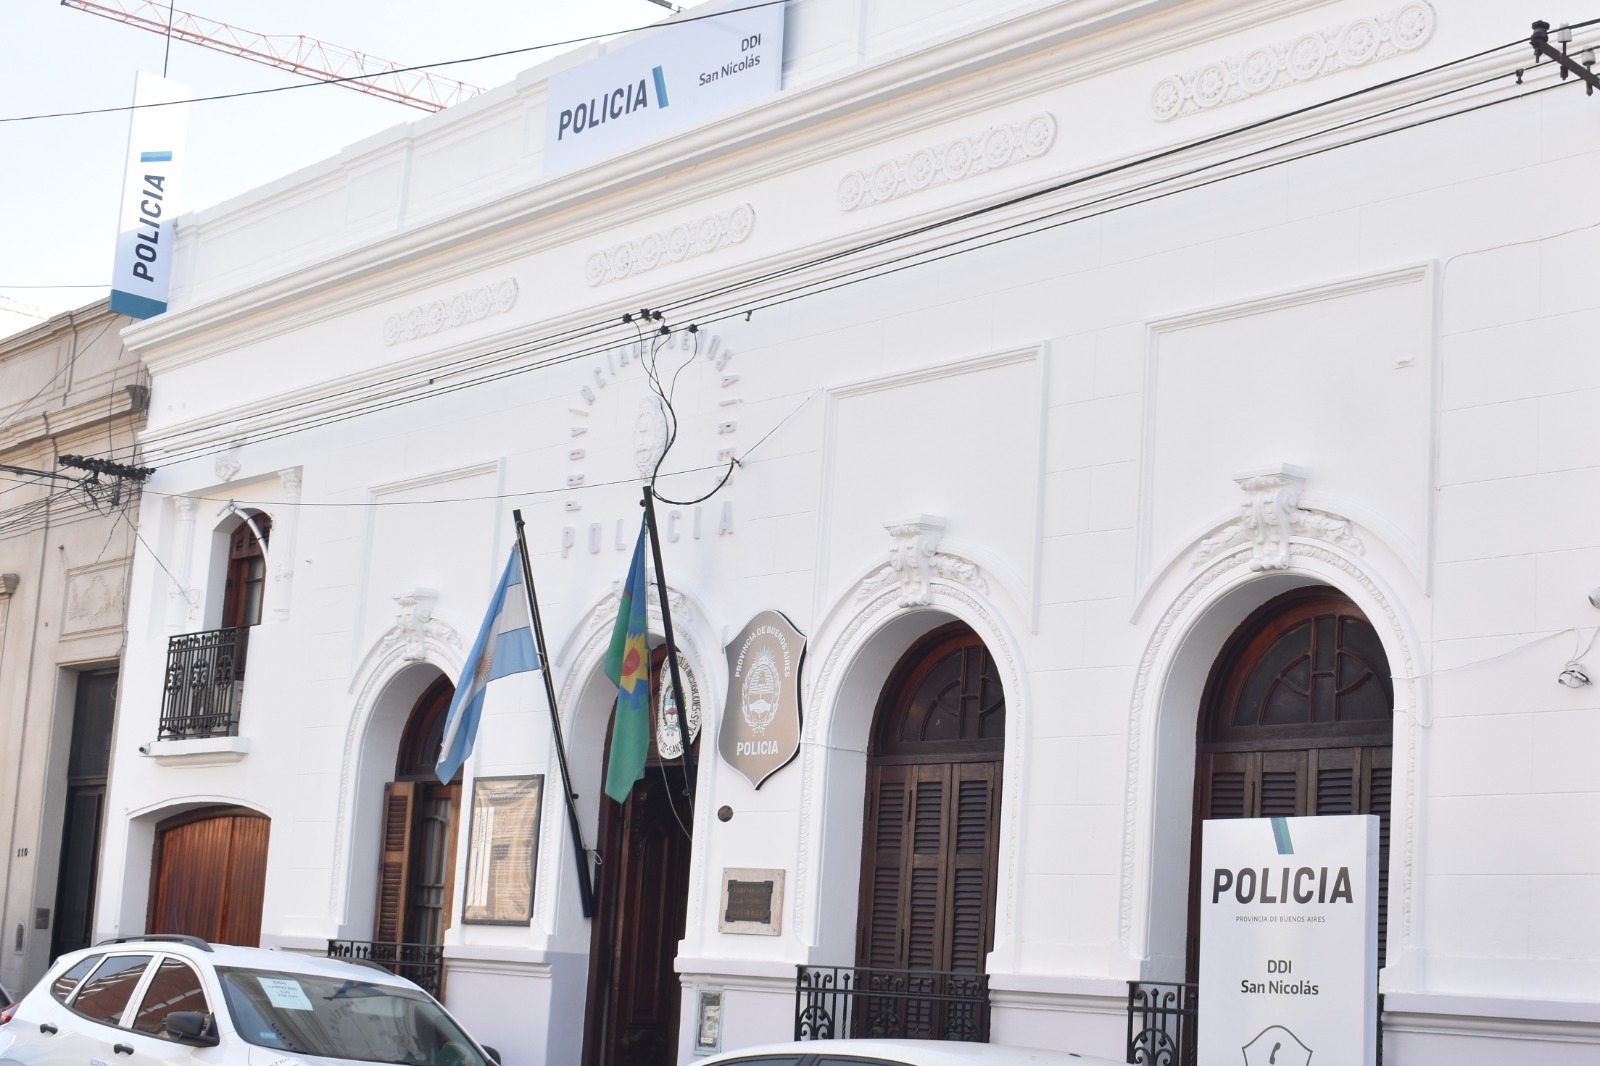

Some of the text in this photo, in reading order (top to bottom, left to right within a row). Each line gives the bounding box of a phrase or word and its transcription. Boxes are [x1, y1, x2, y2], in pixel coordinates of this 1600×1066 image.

[741, 33, 761, 52] DDI
[699, 54, 761, 86] San Nicolás
[558, 78, 648, 141] POLICIA
[132, 174, 165, 283] POLICIA
[561, 500, 735, 558] POLCIA
[735, 625, 791, 678] PROVINCIA DE BUENOS AIRES
[736, 740, 779, 756] POLICIA
[1212, 866, 1353, 904] POLICIA
[1306, 915, 1326, 923] AIRES
[1267, 960, 1292, 974] DDI
[1240, 980, 1319, 995] San Nicolás
